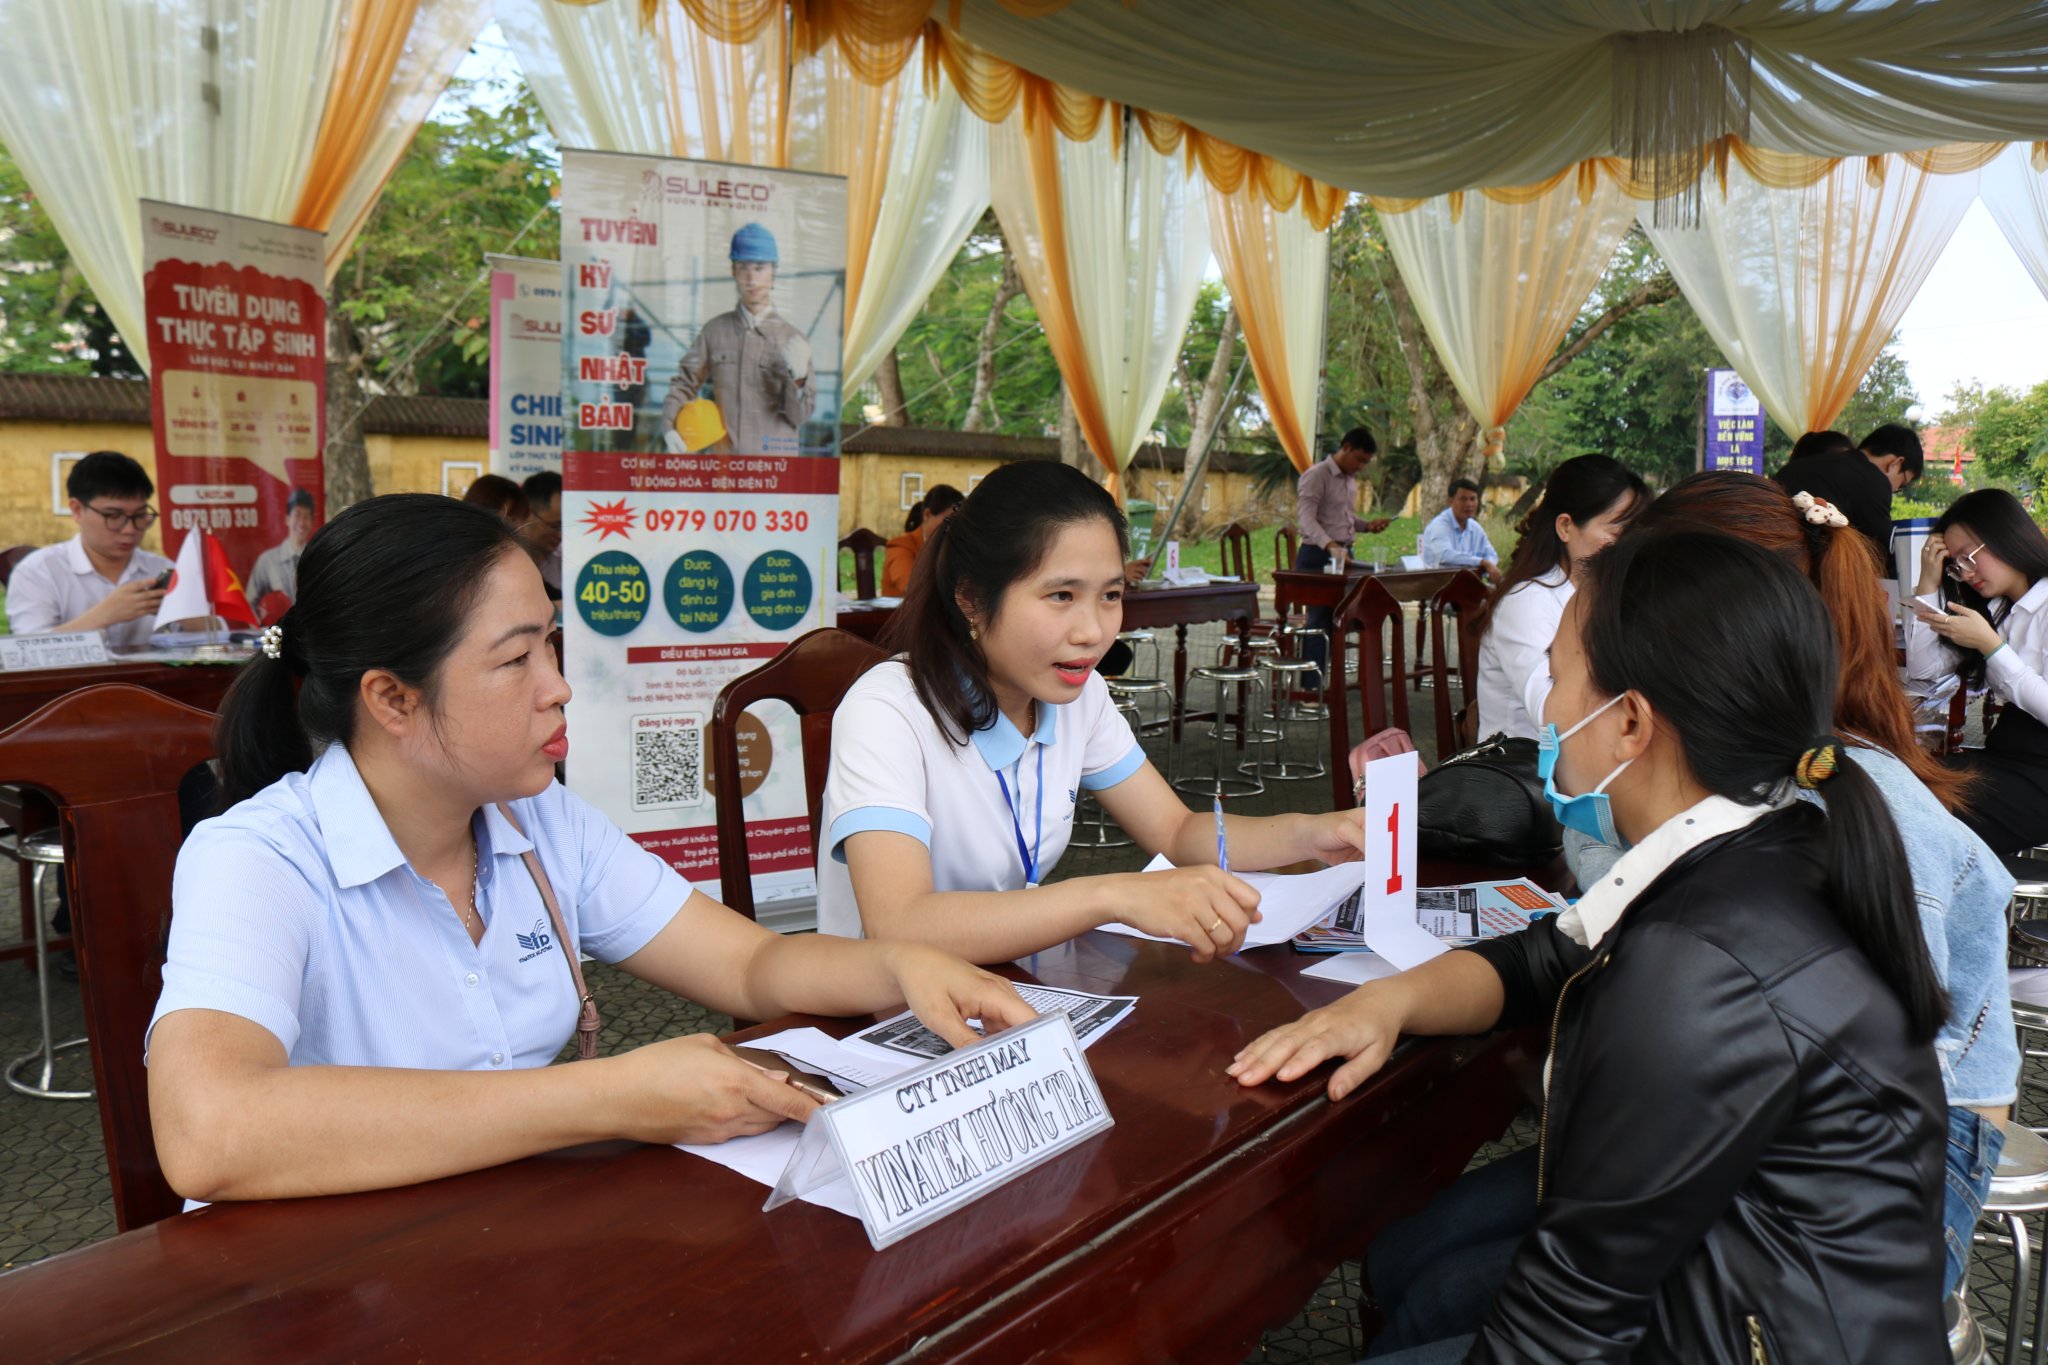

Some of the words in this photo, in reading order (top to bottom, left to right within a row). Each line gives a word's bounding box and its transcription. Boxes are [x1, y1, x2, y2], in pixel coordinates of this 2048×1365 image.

[666, 176, 769, 201] SULECO
[580, 208, 657, 246] TUYỂN
[246, 294, 300, 325] DỤNG
[156, 316, 217, 350] THỰC
[222, 320, 266, 356] TẬP
[579, 353, 648, 390] NHẬT
[579, 395, 632, 429] BẢN
[665, 457, 698, 472] ĐỘNG
[700, 459, 720, 472] LỰC
[747, 458, 772, 473] ĐIỆN
[645, 474, 677, 489] ĐỘNG
[712, 475, 736, 490] ĐIỆN
[738, 476, 763, 490] ĐIỆN
[645, 509, 706, 532] 0979
[714, 510, 757, 532] 070
[765, 510, 809, 532] 330
[592, 564, 612, 575] Thu
[683, 558, 712, 571] Được
[766, 556, 792, 568] Được
[580, 581, 646, 603] 40-50
[750, 606, 772, 616] sang
[685, 647, 706, 660] KIỆN
[708, 647, 731, 657] THAM
[732, 647, 749, 656] GIA
[638, 718, 660, 728] Đăng
[662, 717, 672, 726] ký
[674, 718, 696, 727] ngay
[1386, 802, 1403, 896] 1
[895, 1080, 939, 1114] CTY
[935, 1055, 993, 1098] TNHH
[989, 1038, 1032, 1075] MAY
[855, 1117, 983, 1224] VINATEX
[962, 1079, 1060, 1173] HƯƠNG
[1042, 1047, 1103, 1131] TRÀ
